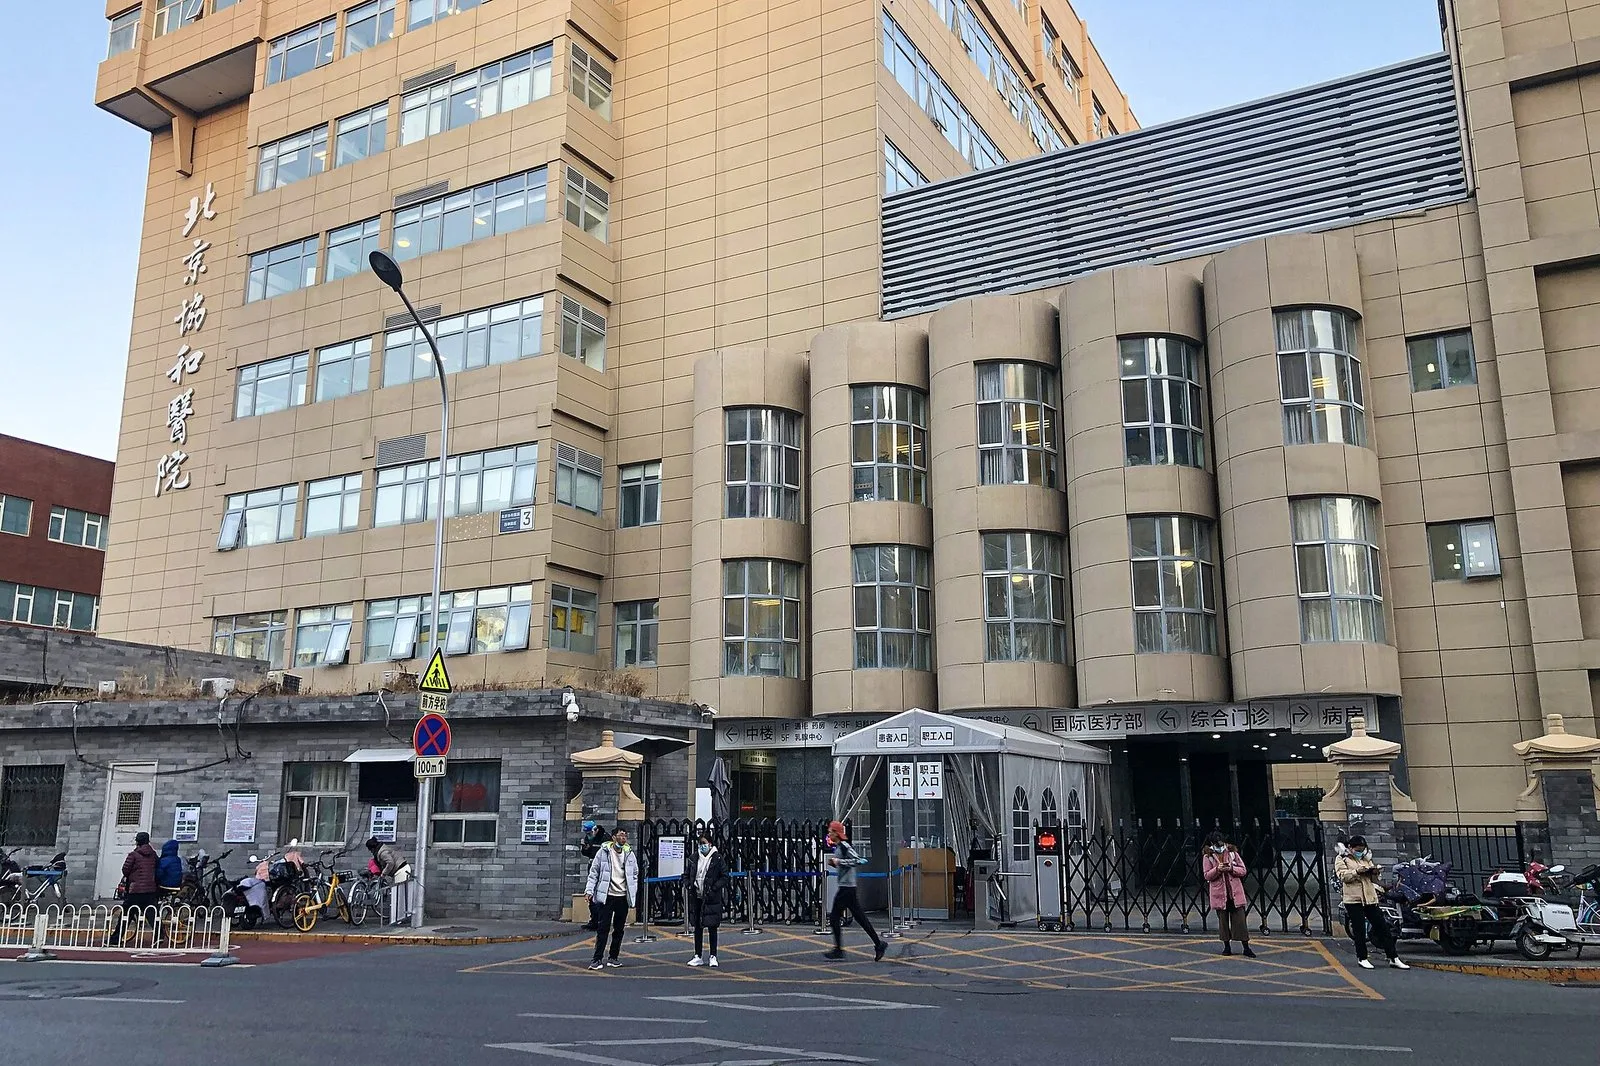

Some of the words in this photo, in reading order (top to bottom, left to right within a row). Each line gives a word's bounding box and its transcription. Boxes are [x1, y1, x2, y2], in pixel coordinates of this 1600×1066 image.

[523, 511, 531, 526] 3
[422, 693, 446, 711] 前方学校
[1051, 713, 1143, 732] 国际医疗部
[1191, 707, 1270, 728] 综合门诊
[746, 725, 773, 742] 中楼
[781, 734, 789, 742] 5F
[879, 733, 908, 743] 患者入口
[922, 731, 953, 741] 职工入口
[417, 761, 437, 774] 100m
[893, 765, 911, 775] 患者
[920, 765, 939, 775] 职工
[893, 777, 911, 787] 入口
[921, 777, 939, 787] 入口
